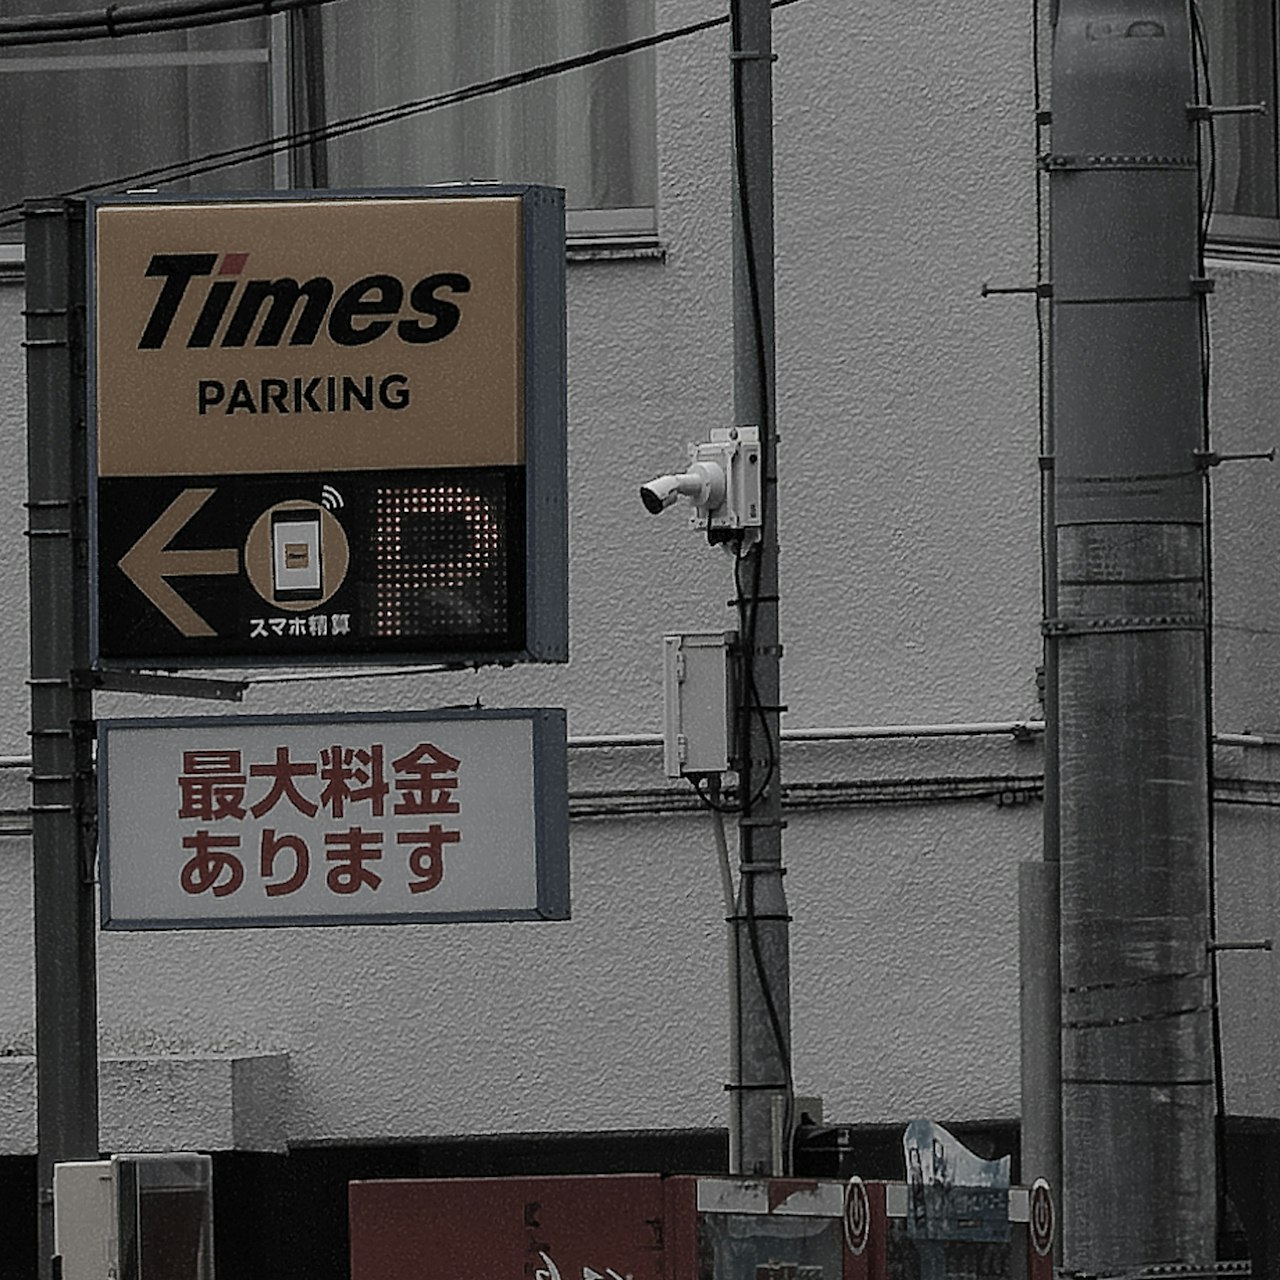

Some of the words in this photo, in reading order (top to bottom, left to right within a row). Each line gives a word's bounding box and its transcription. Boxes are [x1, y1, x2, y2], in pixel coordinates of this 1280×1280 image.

[138, 253, 471, 350] Times
[198, 374, 411, 416] PARKING
[249, 613, 352, 638] スマホ精算
[178, 743, 462, 821] 最大料金
[180, 824, 462, 897] あります
